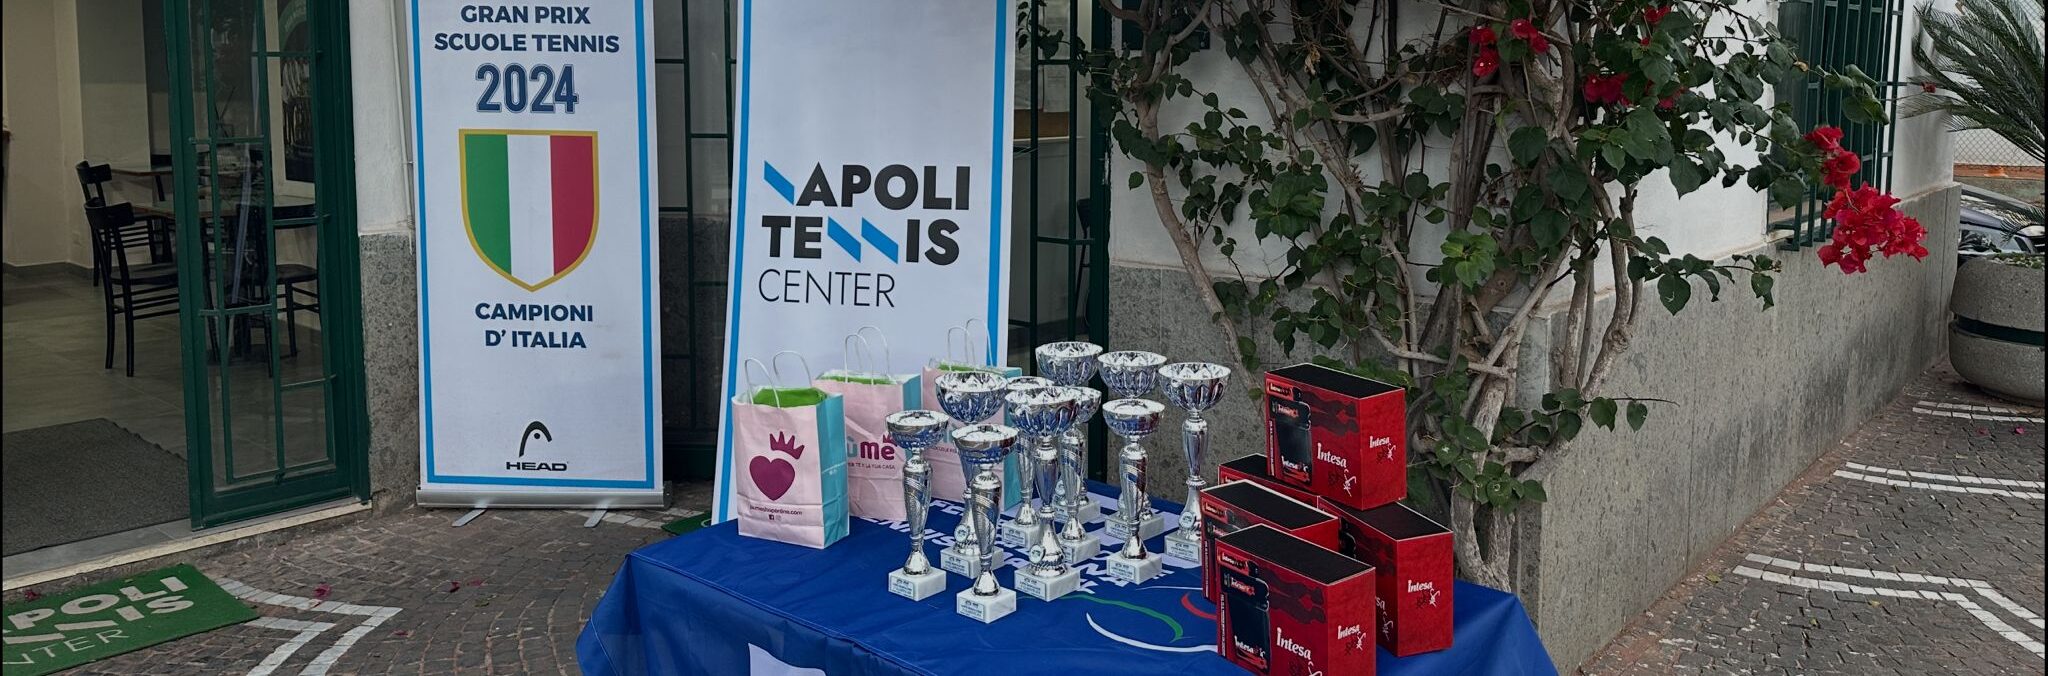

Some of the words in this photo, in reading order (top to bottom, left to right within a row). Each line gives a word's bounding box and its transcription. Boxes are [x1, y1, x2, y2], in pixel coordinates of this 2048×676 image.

[461, 5, 528, 23] GRAN
[535, 6, 591, 24] PRIX
[434, 33, 527, 51] SCUOLE
[532, 34, 620, 53] TENNIS
[475, 63, 579, 114] 2024
[764, 160, 970, 210] NAPOLI
[761, 215, 960, 266] TENNIS
[758, 268, 895, 307] CENTER
[475, 303, 593, 322] CAMPIONI
[1369, 436, 1390, 449] Intesa
[506, 461, 567, 471] HEAD
[1317, 442, 1347, 468] Intesa
[1407, 580, 1433, 593] Intesa
[3, 576, 189, 633] POLI
[1338, 624, 1360, 640] Intesa
[1276, 627, 1312, 661] Intesa
